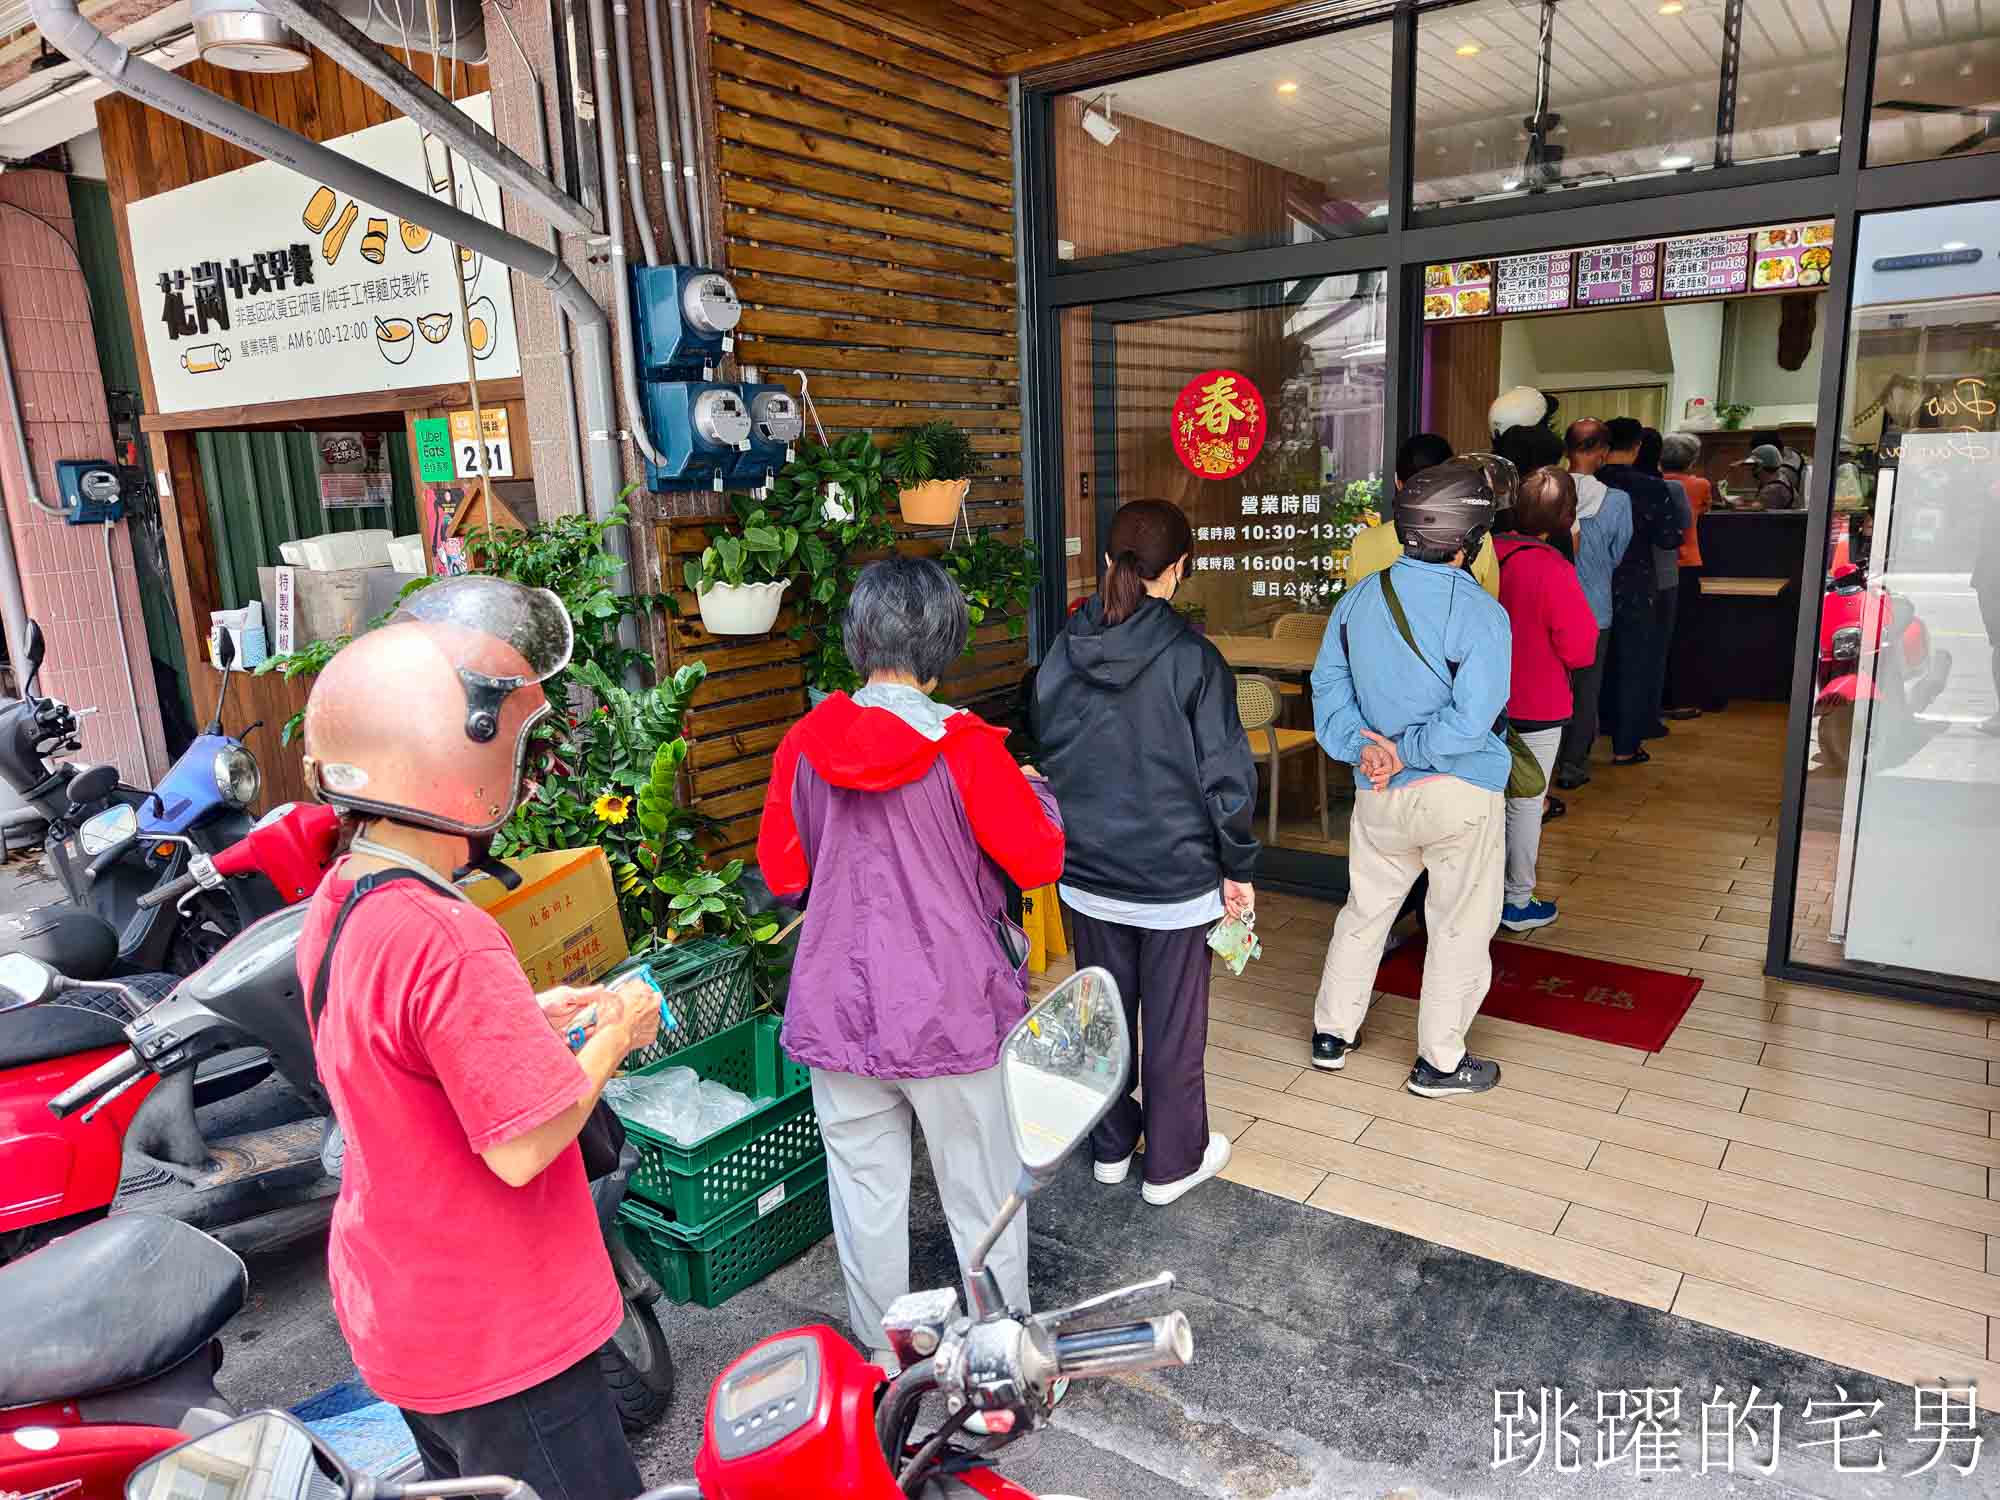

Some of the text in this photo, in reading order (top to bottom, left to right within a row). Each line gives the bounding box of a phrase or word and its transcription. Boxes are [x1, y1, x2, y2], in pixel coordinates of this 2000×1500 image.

[1640, 265, 1655, 278] 90
[1731, 270, 1746, 284] 50
[1640, 279, 1654, 292] 75
[1194, 376, 1246, 435] 春
[420, 431, 442, 442] Uber
[423, 445, 446, 457] Eats
[1241, 494, 1321, 515] 營業時間
[1192, 526, 1237, 541] 餐時段
[1191, 556, 1236, 571] 餐時段
[1252, 581, 1313, 597] 週日公休
